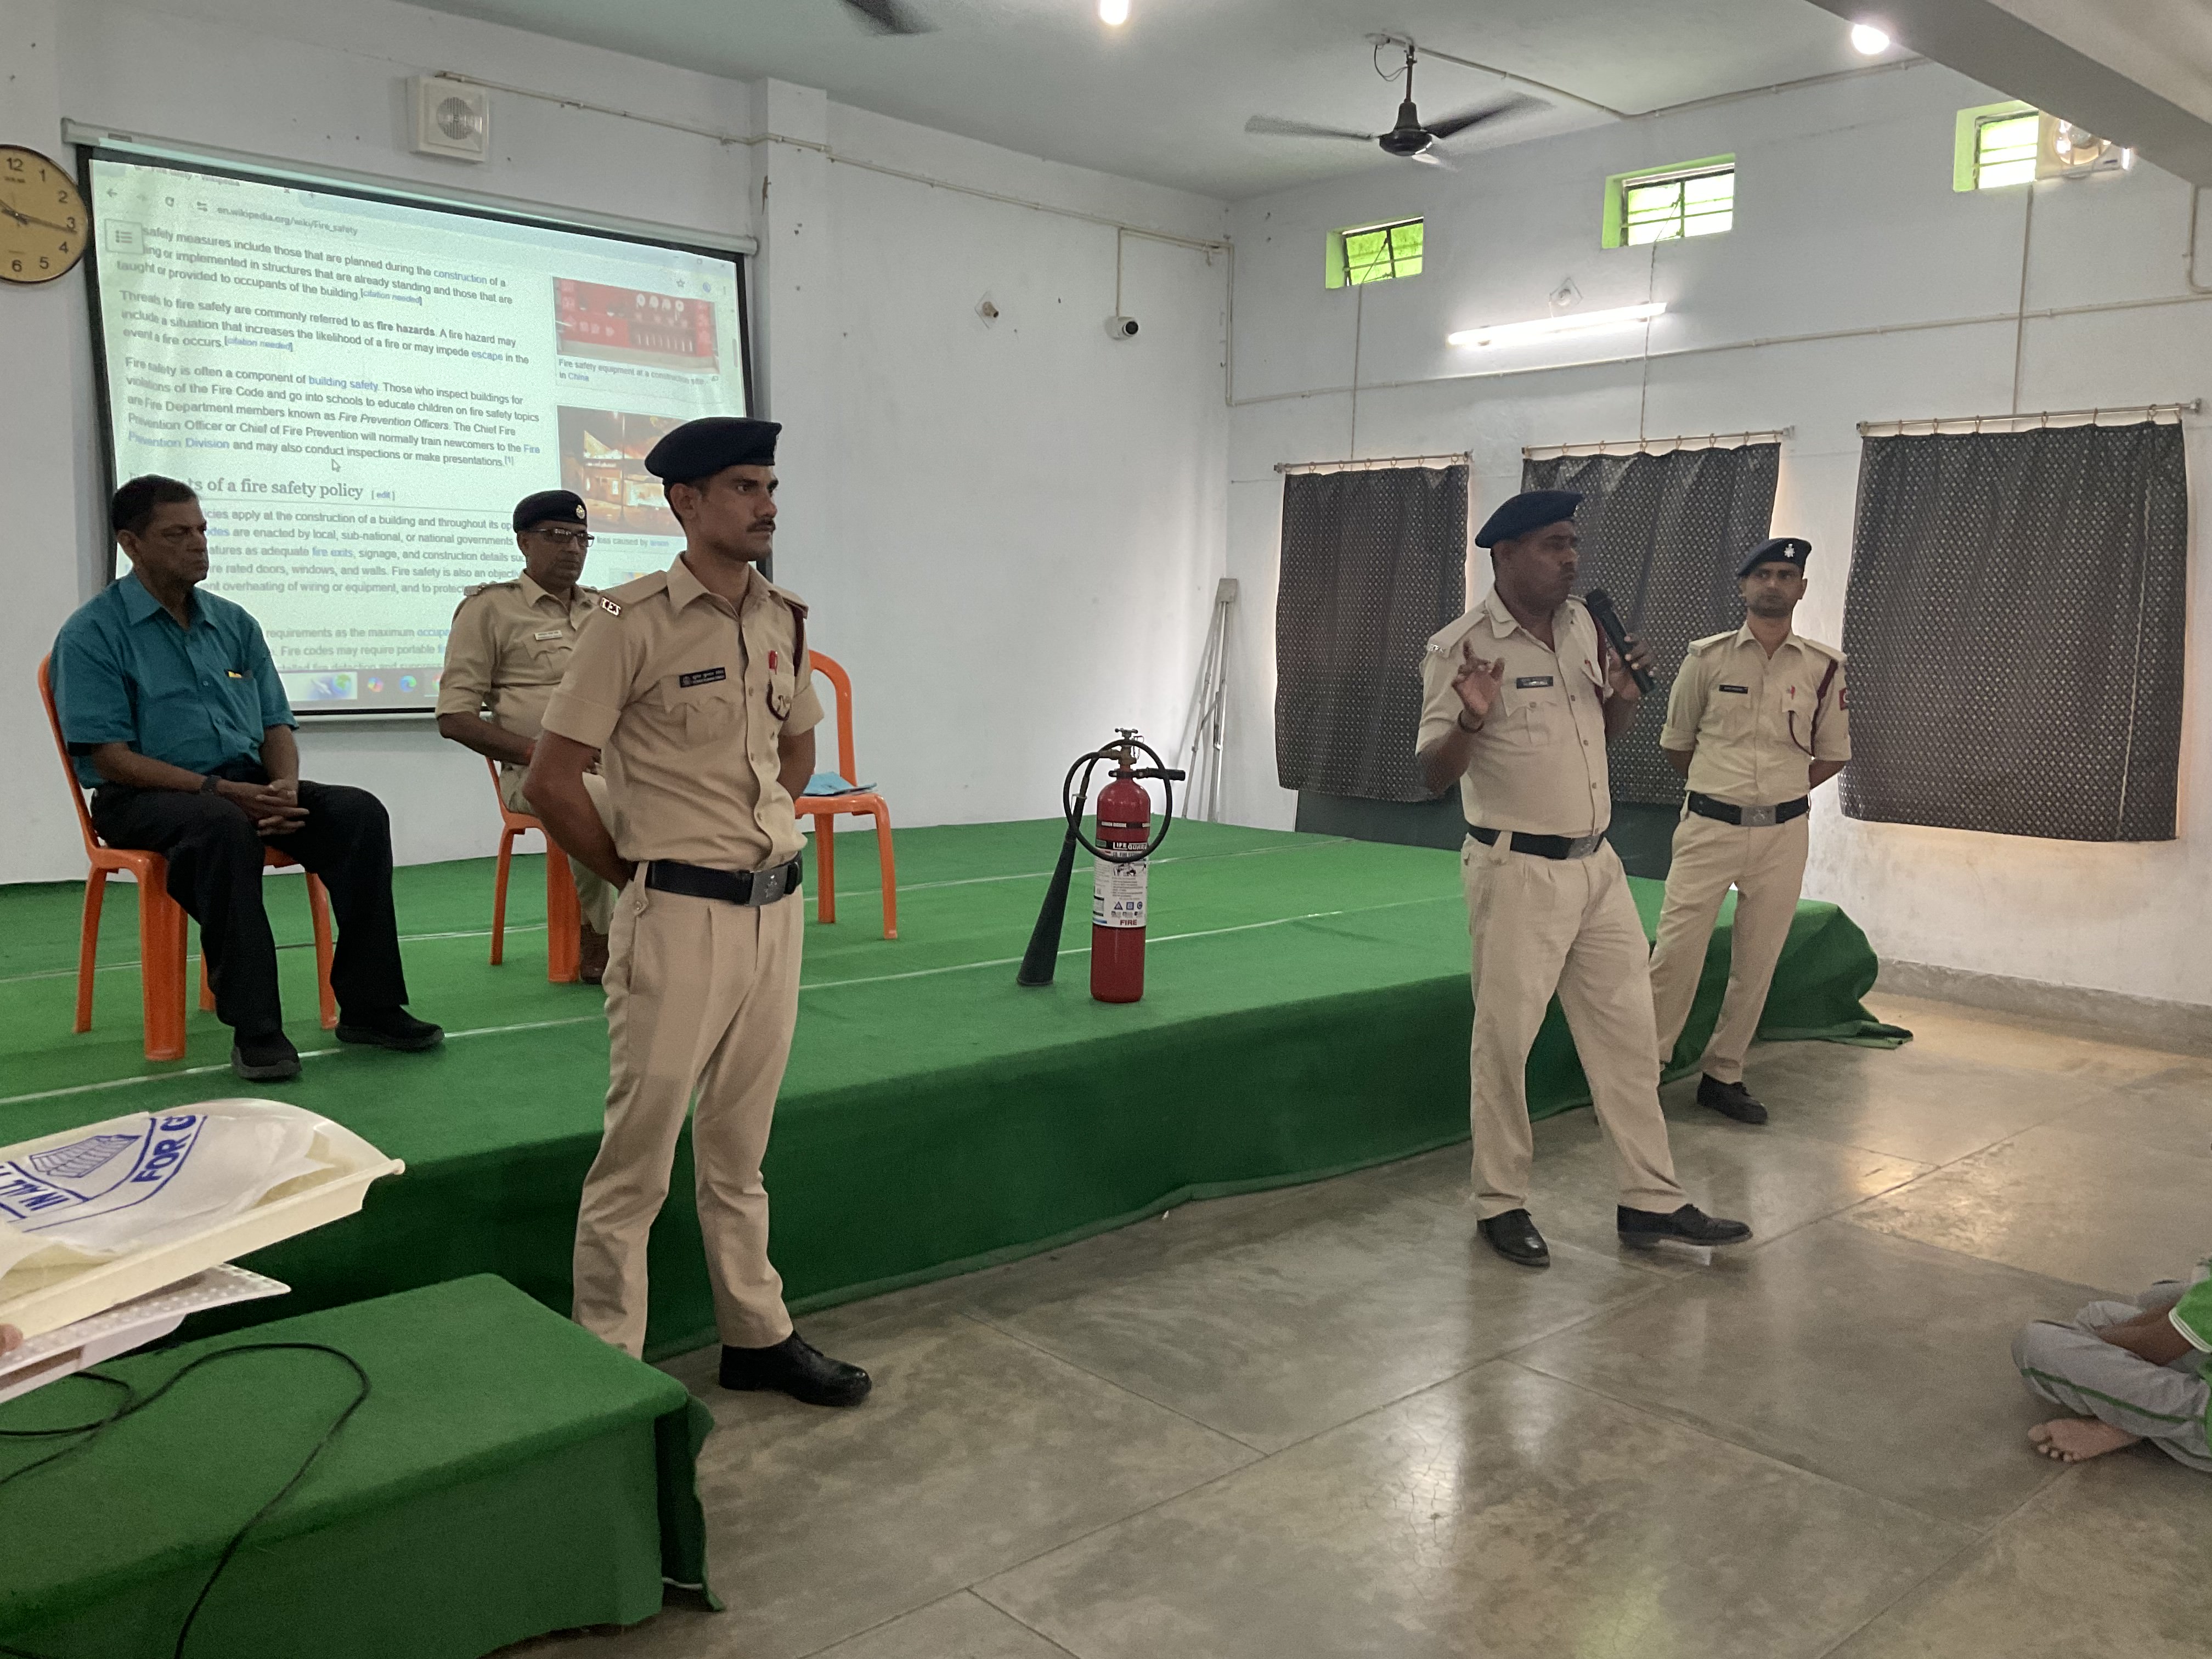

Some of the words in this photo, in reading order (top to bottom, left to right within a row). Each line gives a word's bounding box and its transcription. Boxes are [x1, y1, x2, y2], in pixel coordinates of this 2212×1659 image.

[7, 157, 24, 172] 12
[39, 169, 46, 182] 1
[58, 190, 68, 204] 2
[66, 217, 76, 229] 3
[59, 241, 69, 254] 4
[12, 259, 22, 273] 6
[39, 256, 49, 269] 5
[177, 234, 232, 247] measures
[234, 241, 271, 253] include
[274, 246, 302, 257] those
[304, 250, 323, 261] that
[326, 255, 342, 263] are
[345, 256, 382, 269] planned
[386, 262, 414, 275] during
[417, 266, 431, 275] the
[434, 270, 487, 284] construction
[168, 269, 217, 281] provided
[234, 277, 287, 290] occupants
[302, 284, 317, 294] the
[262, 262, 312, 276] structures
[315, 269, 334, 279] that
[336, 273, 352, 282] are
[354, 275, 390, 289] already
[392, 280, 431, 295] standing
[434, 287, 450, 295] and
[453, 288, 477, 299] those
[480, 292, 496, 302] that
[176, 299, 194, 309] fire
[198, 302, 231, 315] safety
[234, 306, 252, 315] are
[255, 308, 307, 323] commonly
[310, 314, 348, 326] referred
[377, 321, 393, 331] fire
[449, 330, 462, 340] fire
[465, 332, 495, 343] hazard
[498, 338, 516, 348] may
[222, 321, 242, 332] that
[245, 325, 294, 337] increases
[297, 329, 313, 339] the
[316, 331, 362, 345] likelihood
[385, 338, 399, 349] fire
[414, 345, 433, 354] may
[436, 346, 469, 357] impede
[471, 351, 503, 361] escape
[515, 355, 529, 364] the
[558, 359, 573, 368] Fire
[575, 362, 596, 372] safety
[598, 365, 634, 375] equipment
[125, 357, 146, 369] Fire
[194, 366, 223, 377] often
[235, 371, 293, 382] component
[308, 376, 347, 390] building
[383, 382, 412, 393] Those
[415, 386, 434, 396] who
[437, 388, 468, 399] inspect
[471, 391, 509, 404] buildings
[511, 395, 523, 404] for
[568, 373, 589, 381] China
[189, 383, 208, 393] the
[212, 384, 232, 395] Fire
[236, 386, 264, 397] Code
[267, 390, 286, 399] and
[305, 393, 323, 402] into
[326, 395, 363, 405] schools
[377, 399, 415, 410] educate
[417, 403, 453, 413] children
[470, 407, 483, 416] fire
[486, 410, 512, 421] safety
[515, 411, 539, 422] topics
[166, 401, 233, 414] Department
[236, 406, 285, 417] members
[288, 408, 321, 419] known
[338, 412, 357, 422] Fire
[360, 414, 411, 426] Prevention
[454, 422, 471, 432] The
[473, 424, 496, 434] Chief
[499, 426, 515, 436] Fire
[184, 420, 222, 431] Officer
[239, 422, 267, 433] Chief
[283, 426, 302, 436] Fire
[306, 427, 358, 439] Prevention
[360, 432, 376, 441] will
[379, 435, 419, 446] normally
[421, 437, 442, 445] train
[444, 439, 494, 450] newcomers
[507, 443, 521, 452] the
[524, 444, 540, 453] Fire
[185, 438, 229, 448] Division
[233, 441, 253, 450] and
[256, 443, 278, 453] may
[281, 443, 302, 453] also
[305, 445, 344, 455] conduct
[347, 447, 400, 459] inspections
[415, 453, 440, 462] make
[207, 477, 224, 491] of
[241, 478, 267, 493] fire
[272, 481, 317, 498] safety
[320, 483, 363, 500] policy
[232, 510, 261, 522] apply
[276, 511, 292, 521] the
[295, 513, 356, 523] construction
[379, 515, 415, 527] building
[418, 517, 435, 526] and
[438, 518, 486, 529] throughout
[489, 521, 498, 529] its
[253, 528, 295, 538] enacted
[418, 534, 454, 543] national
[457, 537, 513, 545] governments
[261, 546, 309, 558] adequate
[403, 550, 420, 559] and
[422, 551, 477, 560] construction
[480, 552, 508, 561] details
[226, 564, 253, 573] rated
[341, 566, 359, 575] and
[392, 566, 410, 575] Fire
[413, 567, 441, 578] safety
[453, 568, 472, 577] also
[223, 581, 285, 592] overheating
[301, 582, 330, 594] wiring
[267, 628, 332, 640] requirements
[350, 628, 365, 636] the
[281, 646, 301, 656] Fire
[303, 645, 334, 655] codes
[337, 647, 358, 657] may
[360, 647, 394, 657] require
[397, 644, 435, 656] portable
[1113, 842, 1128, 850] LIFE
[130, 1133, 191, 1183] FOR
